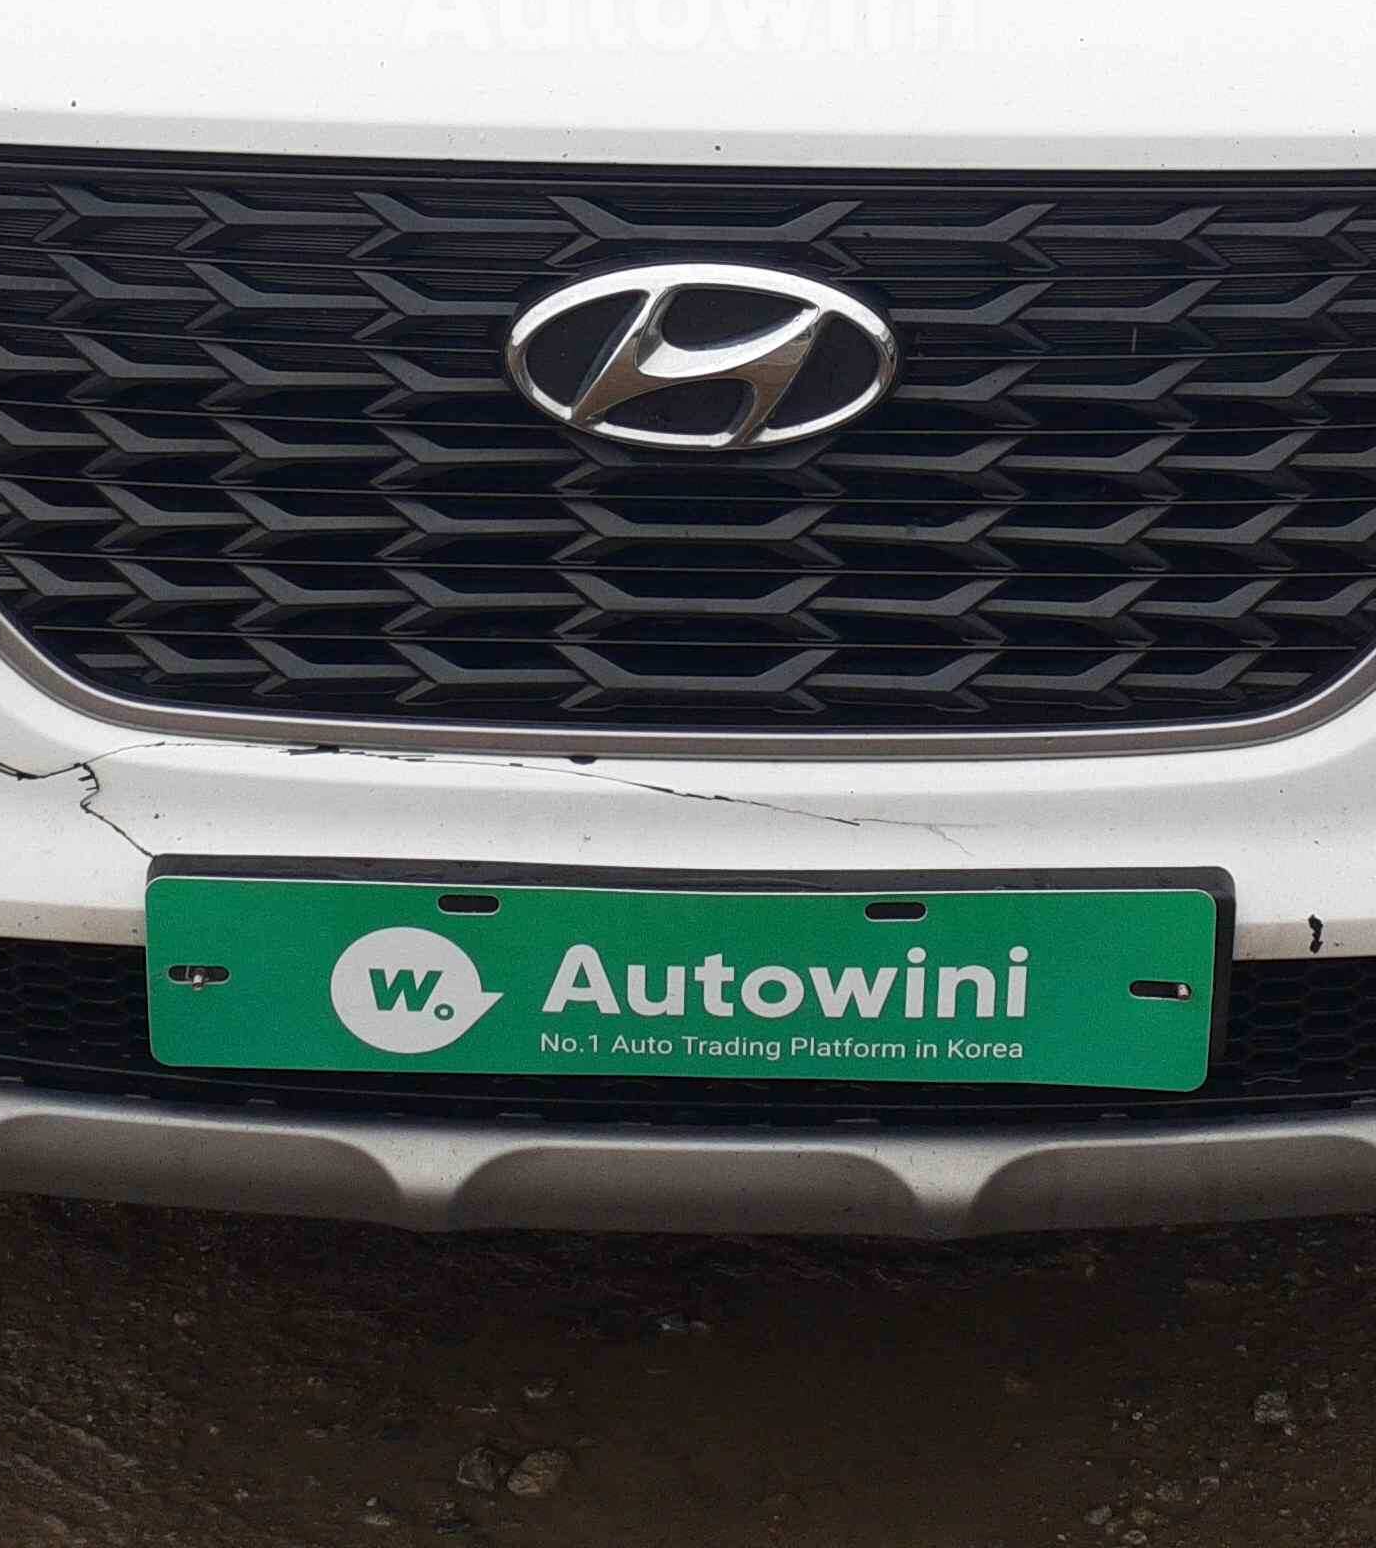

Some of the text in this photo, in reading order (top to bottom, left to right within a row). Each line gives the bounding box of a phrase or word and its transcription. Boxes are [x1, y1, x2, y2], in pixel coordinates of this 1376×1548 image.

[541, 943, 1029, 1019] Autowini
[540, 1032, 1024, 1061] No.1 Auto Trading Platform in Korea
